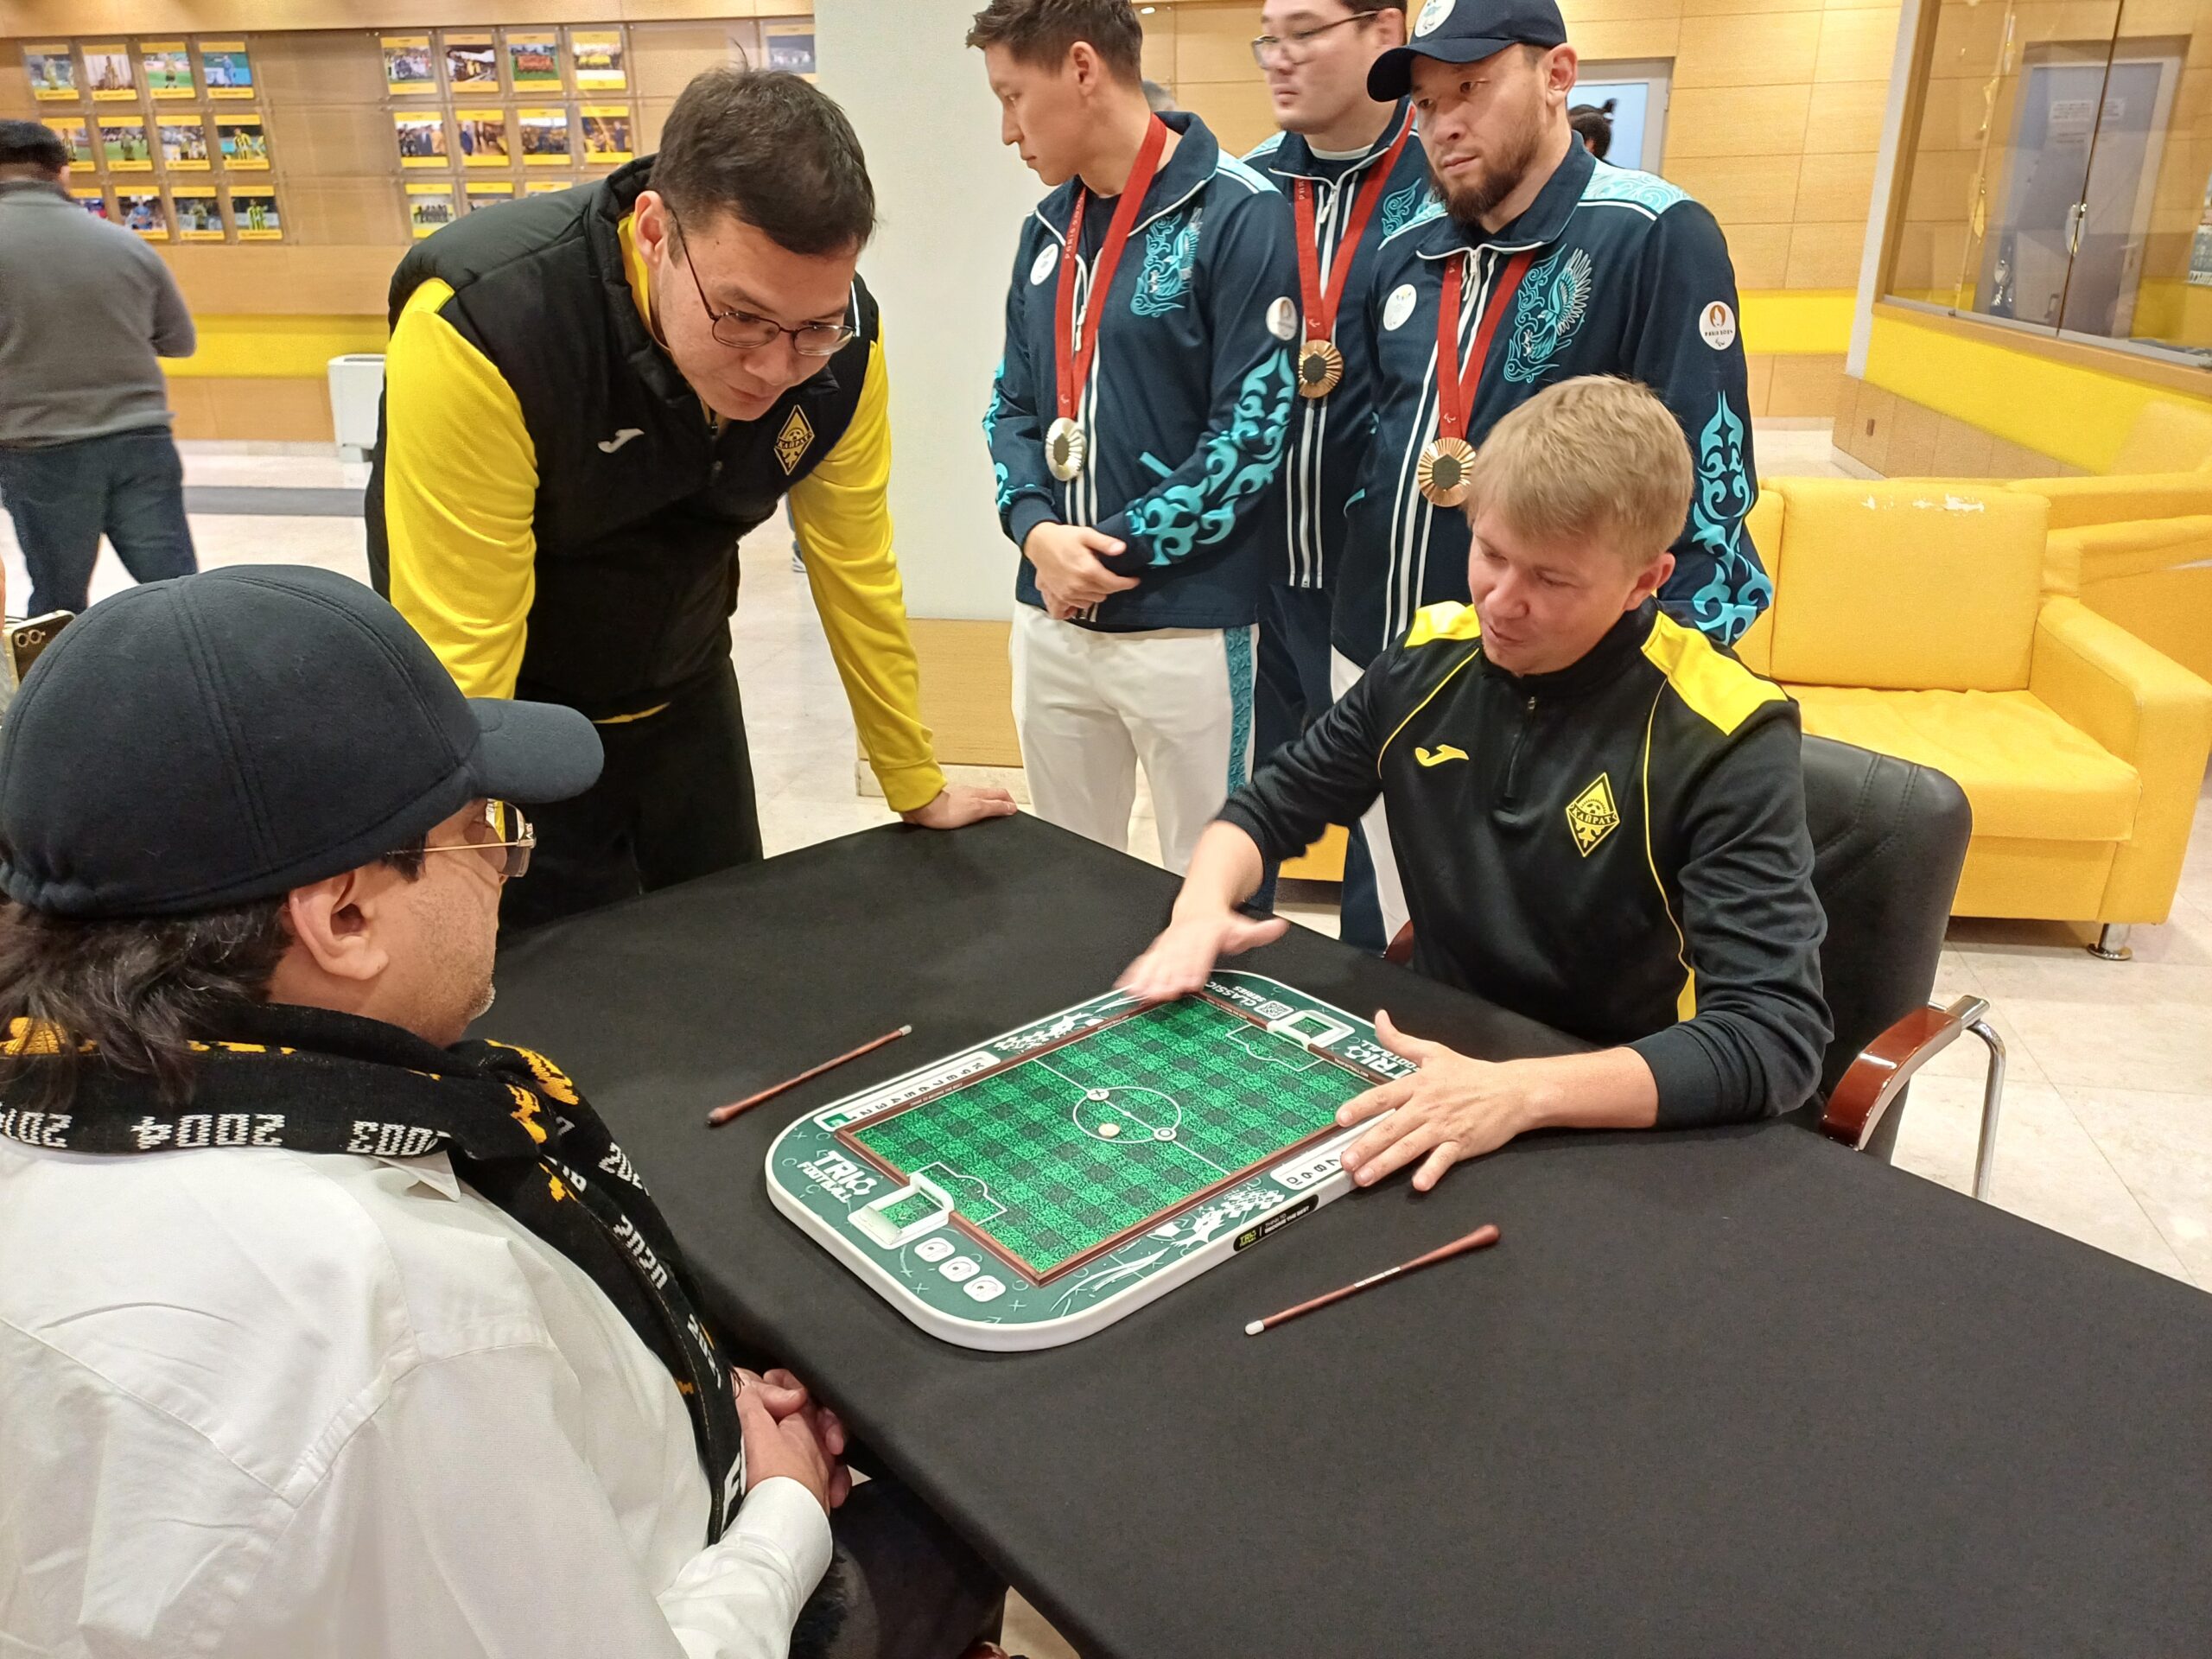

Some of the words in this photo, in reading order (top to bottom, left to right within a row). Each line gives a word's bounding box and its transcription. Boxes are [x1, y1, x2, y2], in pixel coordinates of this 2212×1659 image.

[1572, 807, 1611, 825] КАЙРАТ
[1205, 981, 1257, 1007] CLASSIC
[1232, 986, 1267, 1002] SERIES
[130, 1114, 285, 1149] 2004
[797, 1160, 853, 1204] FOOTBALL
[813, 1150, 878, 1196] TRIO
